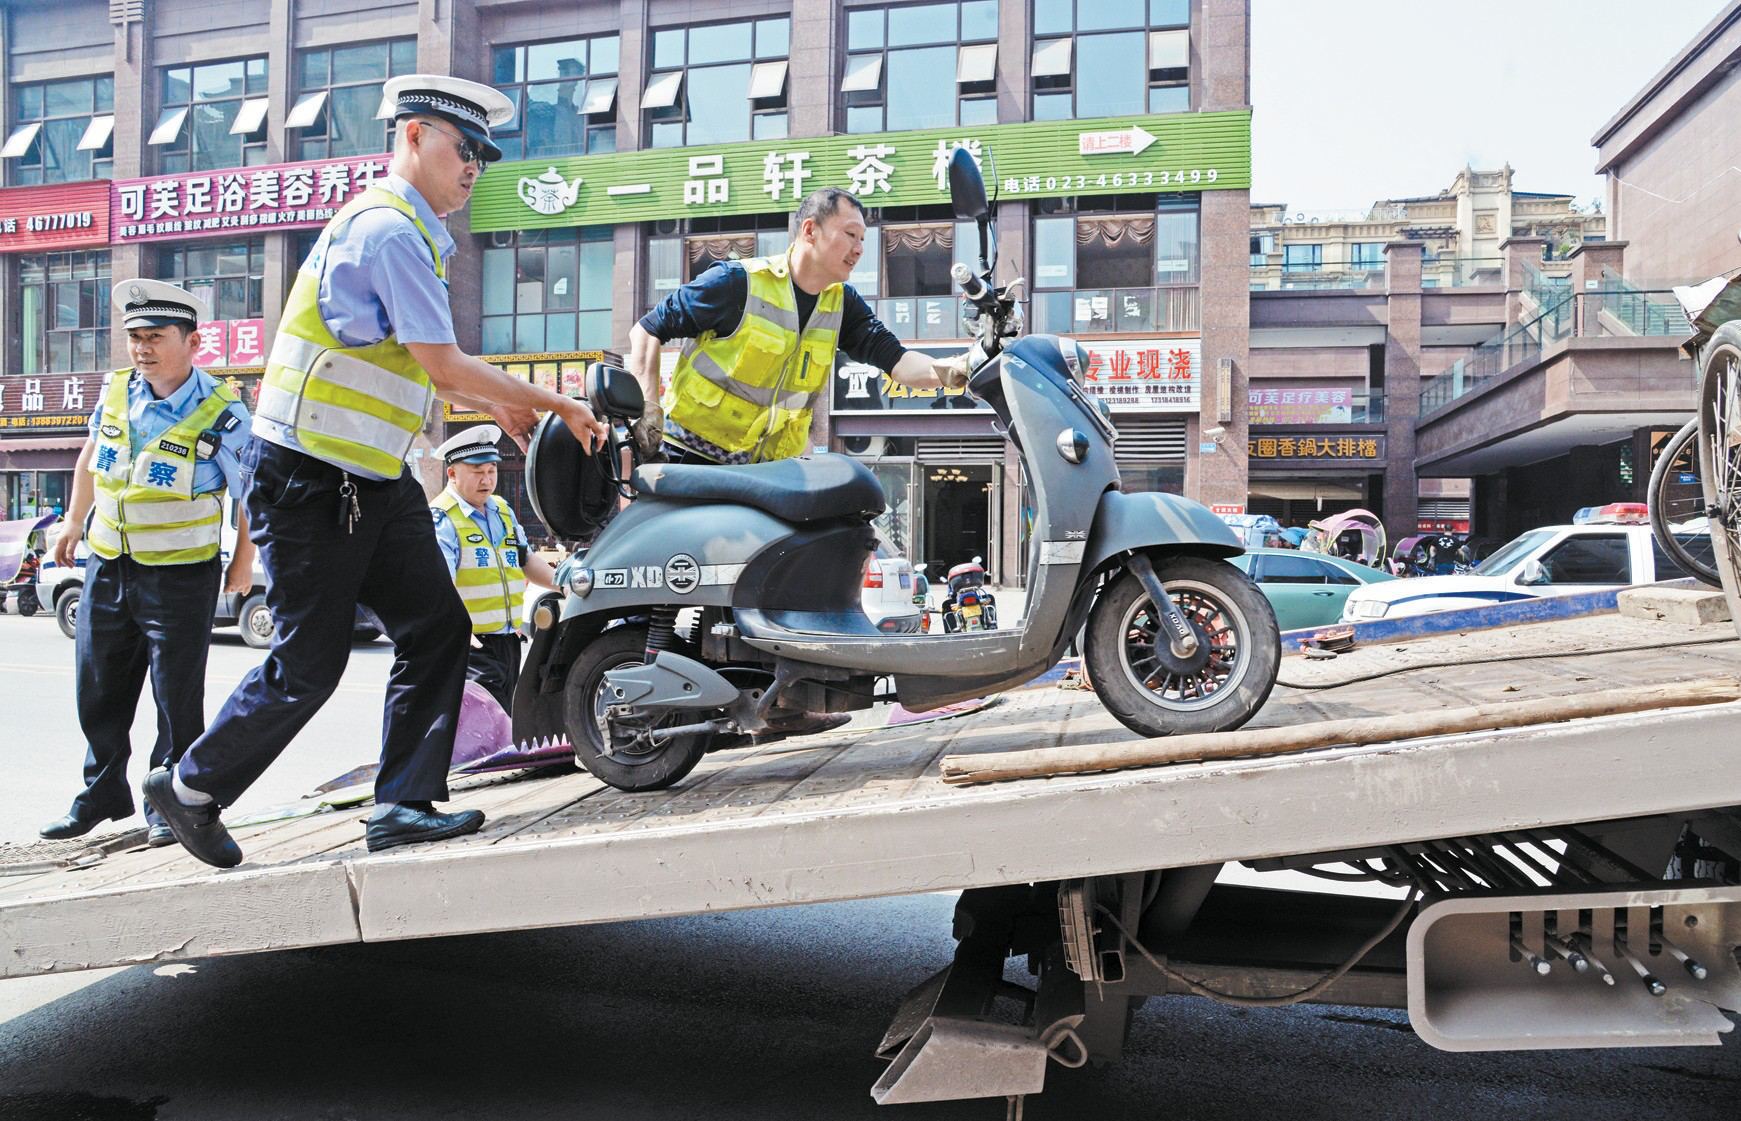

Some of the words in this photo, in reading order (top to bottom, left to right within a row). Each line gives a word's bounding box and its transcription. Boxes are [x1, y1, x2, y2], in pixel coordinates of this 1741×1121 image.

[1082, 134, 1132, 150] 请上二楼
[118, 161, 384, 220] 可芙足浴美容养生
[1004, 176, 1040, 193] 电话
[1046, 169, 1218, 190] 023-46333499
[0, 218, 16, 233] 话
[26, 212, 91, 231] 46777019
[198, 326, 259, 356] 芙足
[1085, 348, 1192, 381] 专业现浇
[0, 376, 84, 411] 品店
[1249, 391, 1346, 405] 可芙足疗美容
